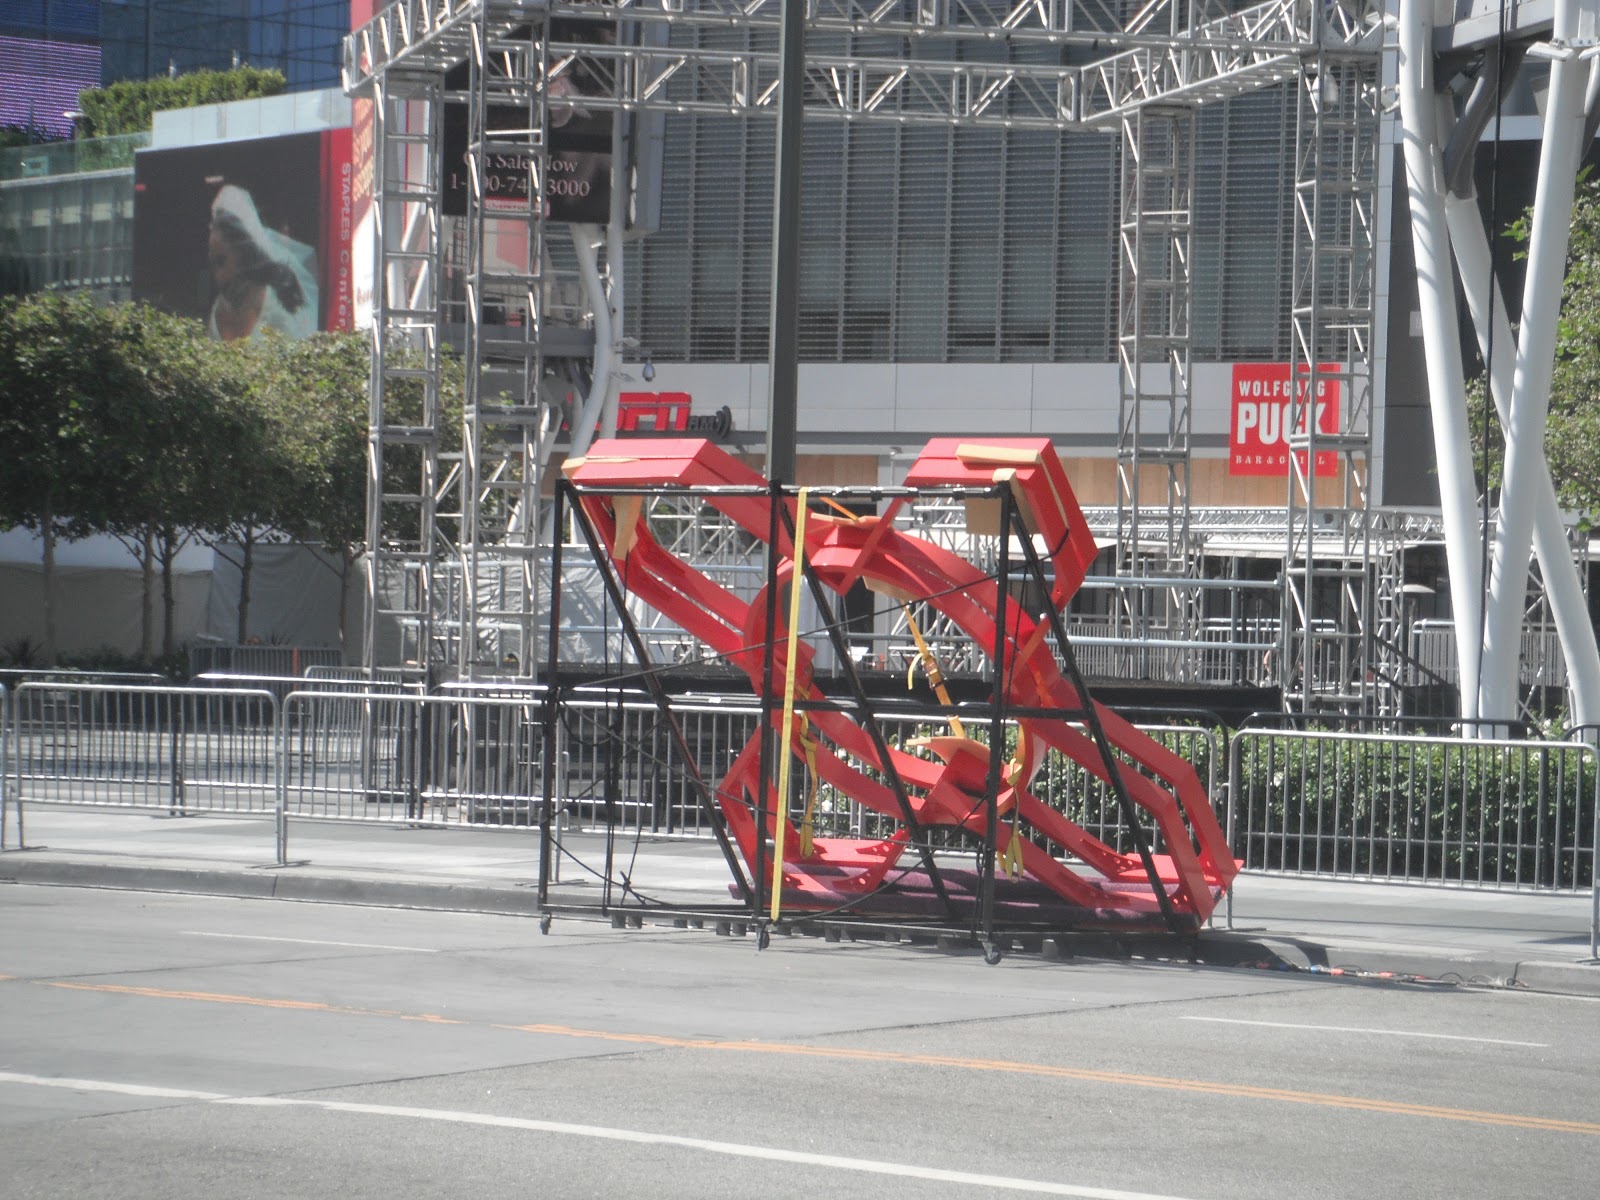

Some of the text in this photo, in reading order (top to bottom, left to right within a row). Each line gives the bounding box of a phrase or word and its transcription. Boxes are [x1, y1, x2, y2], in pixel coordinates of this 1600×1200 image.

[495, 153, 530, 170] Sale
[537, 154, 578, 172] Now
[451, 173, 591, 197] 1-00-743000
[339, 162, 351, 327] STAPLES Center
[1237, 402, 1326, 445] PUCK
[1235, 455, 1262, 465] BAR
[1279, 455, 1325, 465] GIL
